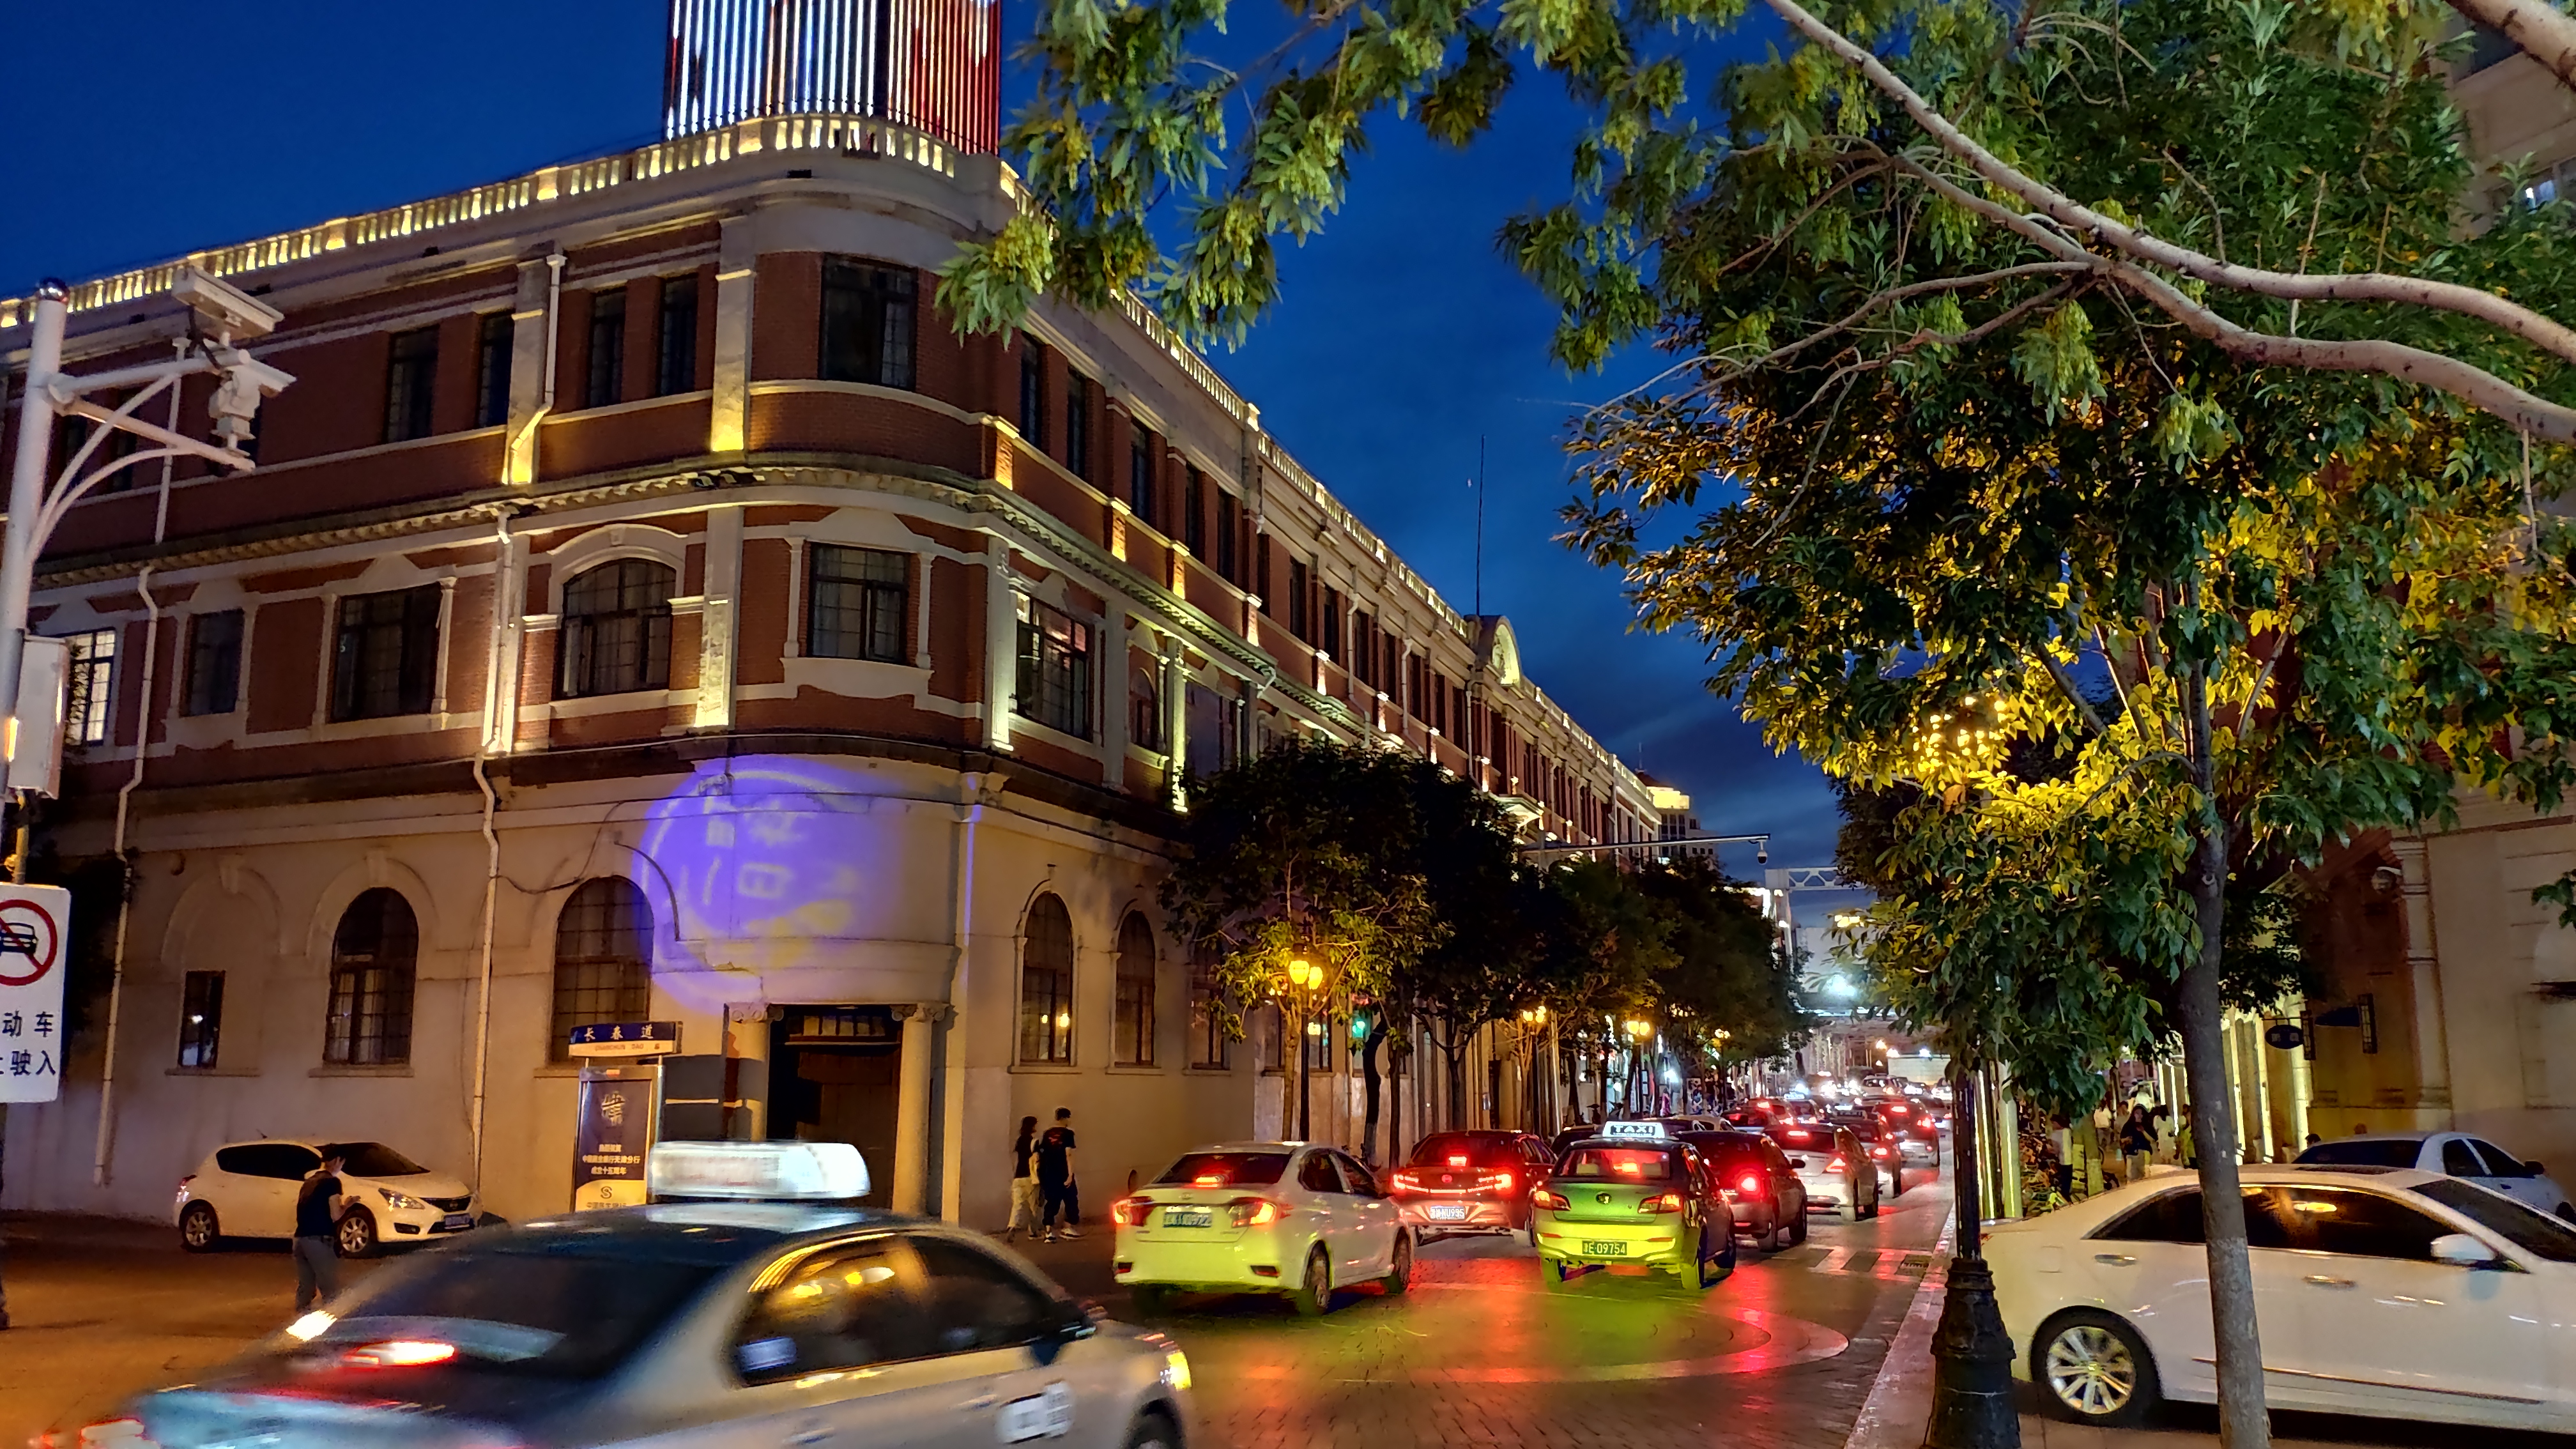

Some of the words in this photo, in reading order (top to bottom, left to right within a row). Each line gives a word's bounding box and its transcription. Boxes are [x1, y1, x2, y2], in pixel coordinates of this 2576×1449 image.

[2, 1009, 54, 1038] 动车
[584, 1023, 654, 1041] 长春道
[0, 1049, 56, 1076] 驶入
[1614, 1125, 1653, 1133] TAXI
